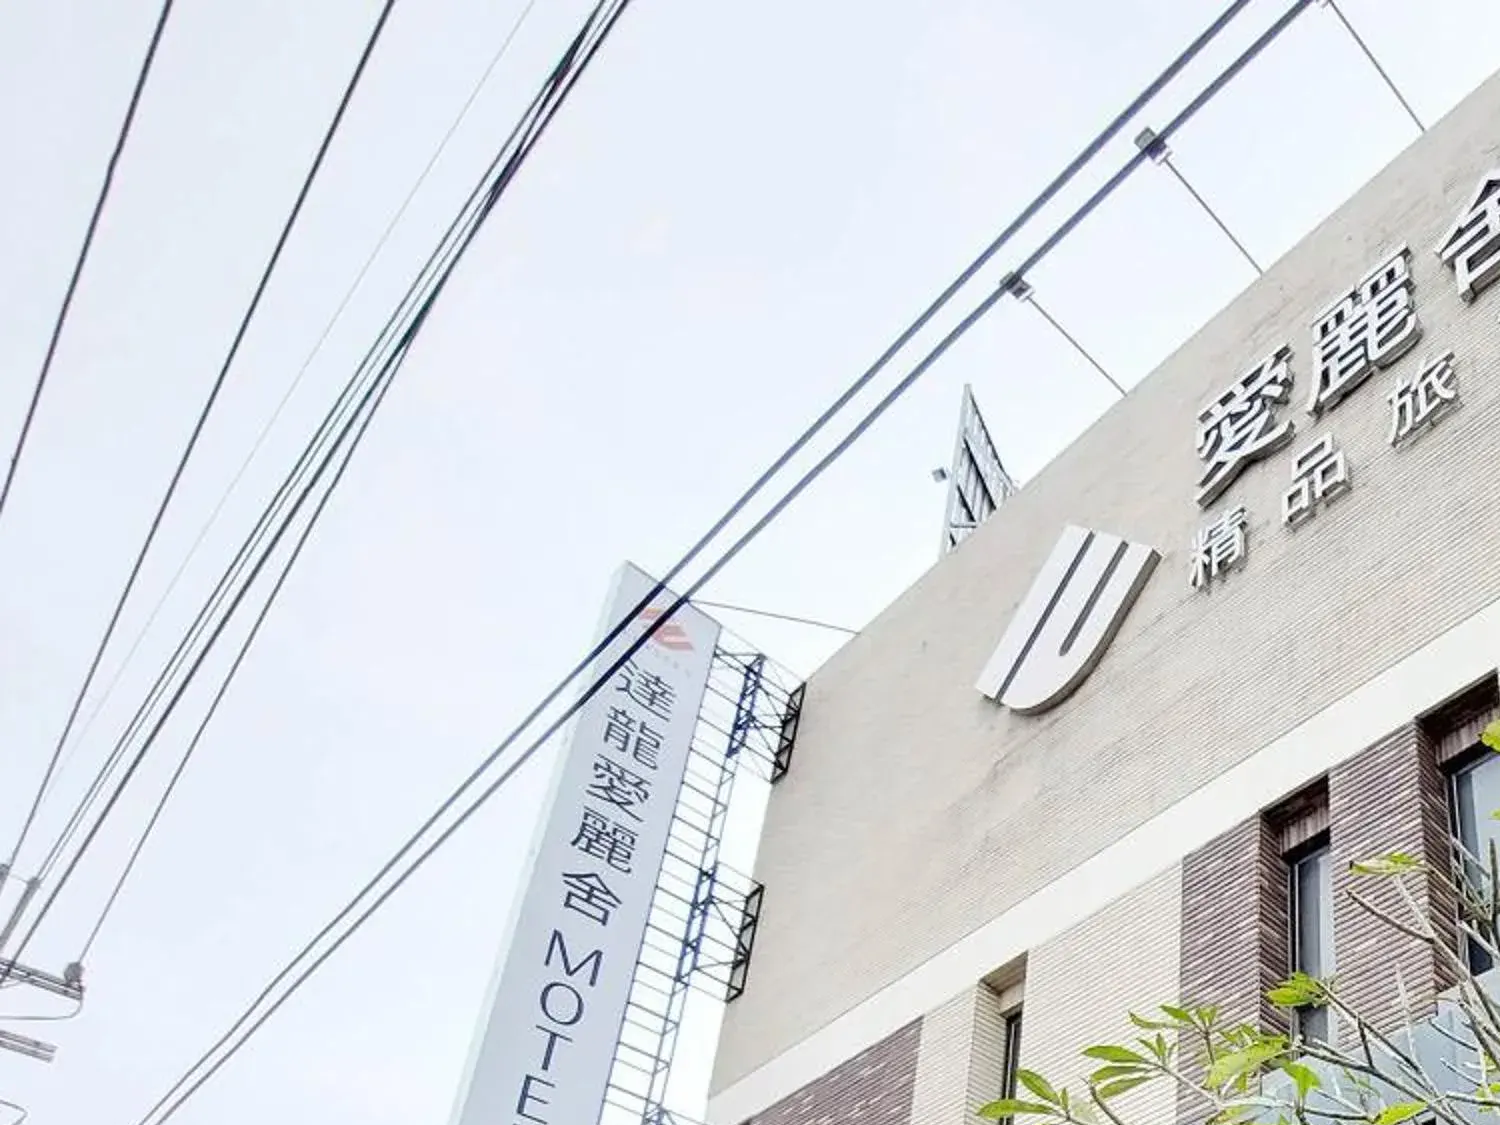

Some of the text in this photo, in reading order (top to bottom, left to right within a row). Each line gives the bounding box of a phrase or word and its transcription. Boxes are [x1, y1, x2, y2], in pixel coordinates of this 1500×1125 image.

[560, 658, 678, 928] 達龍愛麗舍
